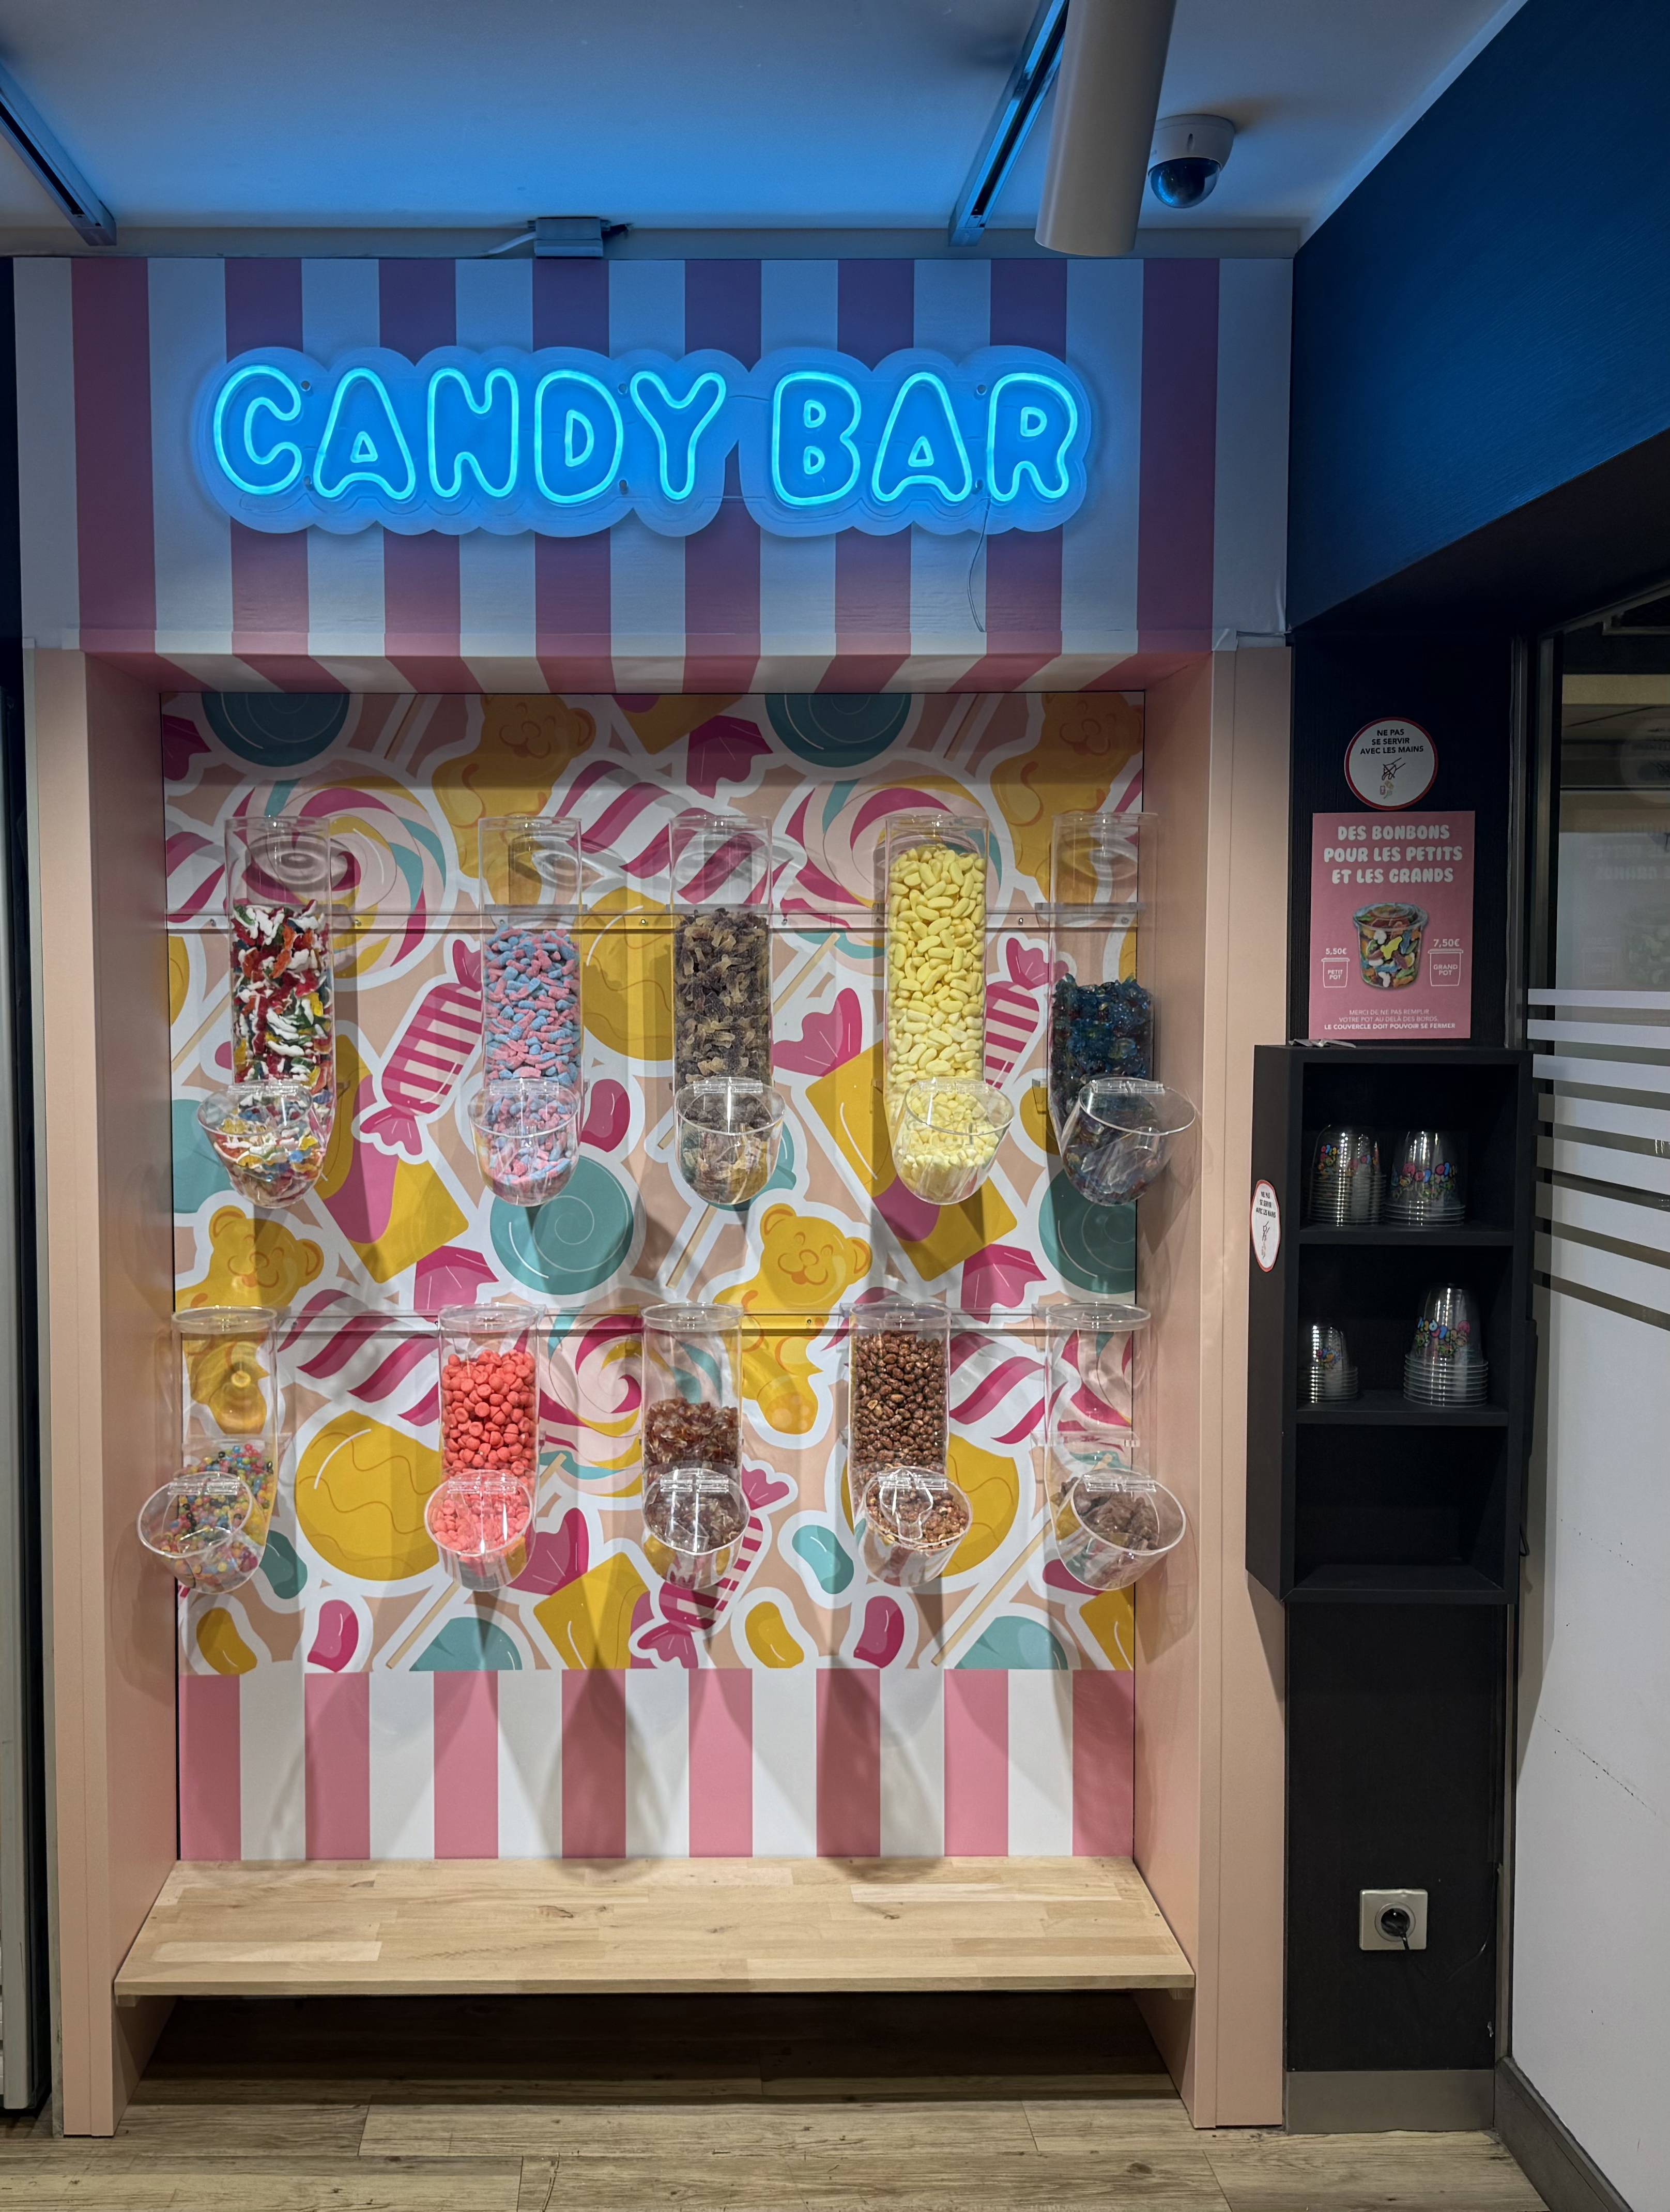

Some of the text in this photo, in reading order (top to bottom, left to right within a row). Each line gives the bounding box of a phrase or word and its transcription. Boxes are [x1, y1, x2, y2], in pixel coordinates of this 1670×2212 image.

[212, 365, 1079, 507] CANDY BAR
[1338, 825, 1450, 841] DES BONBONS
[1324, 846, 1463, 862] POUR LES PETITS
[1332, 868, 1453, 884] ET LES GRANDS
[1433, 939, 1460, 948] 7,50€
